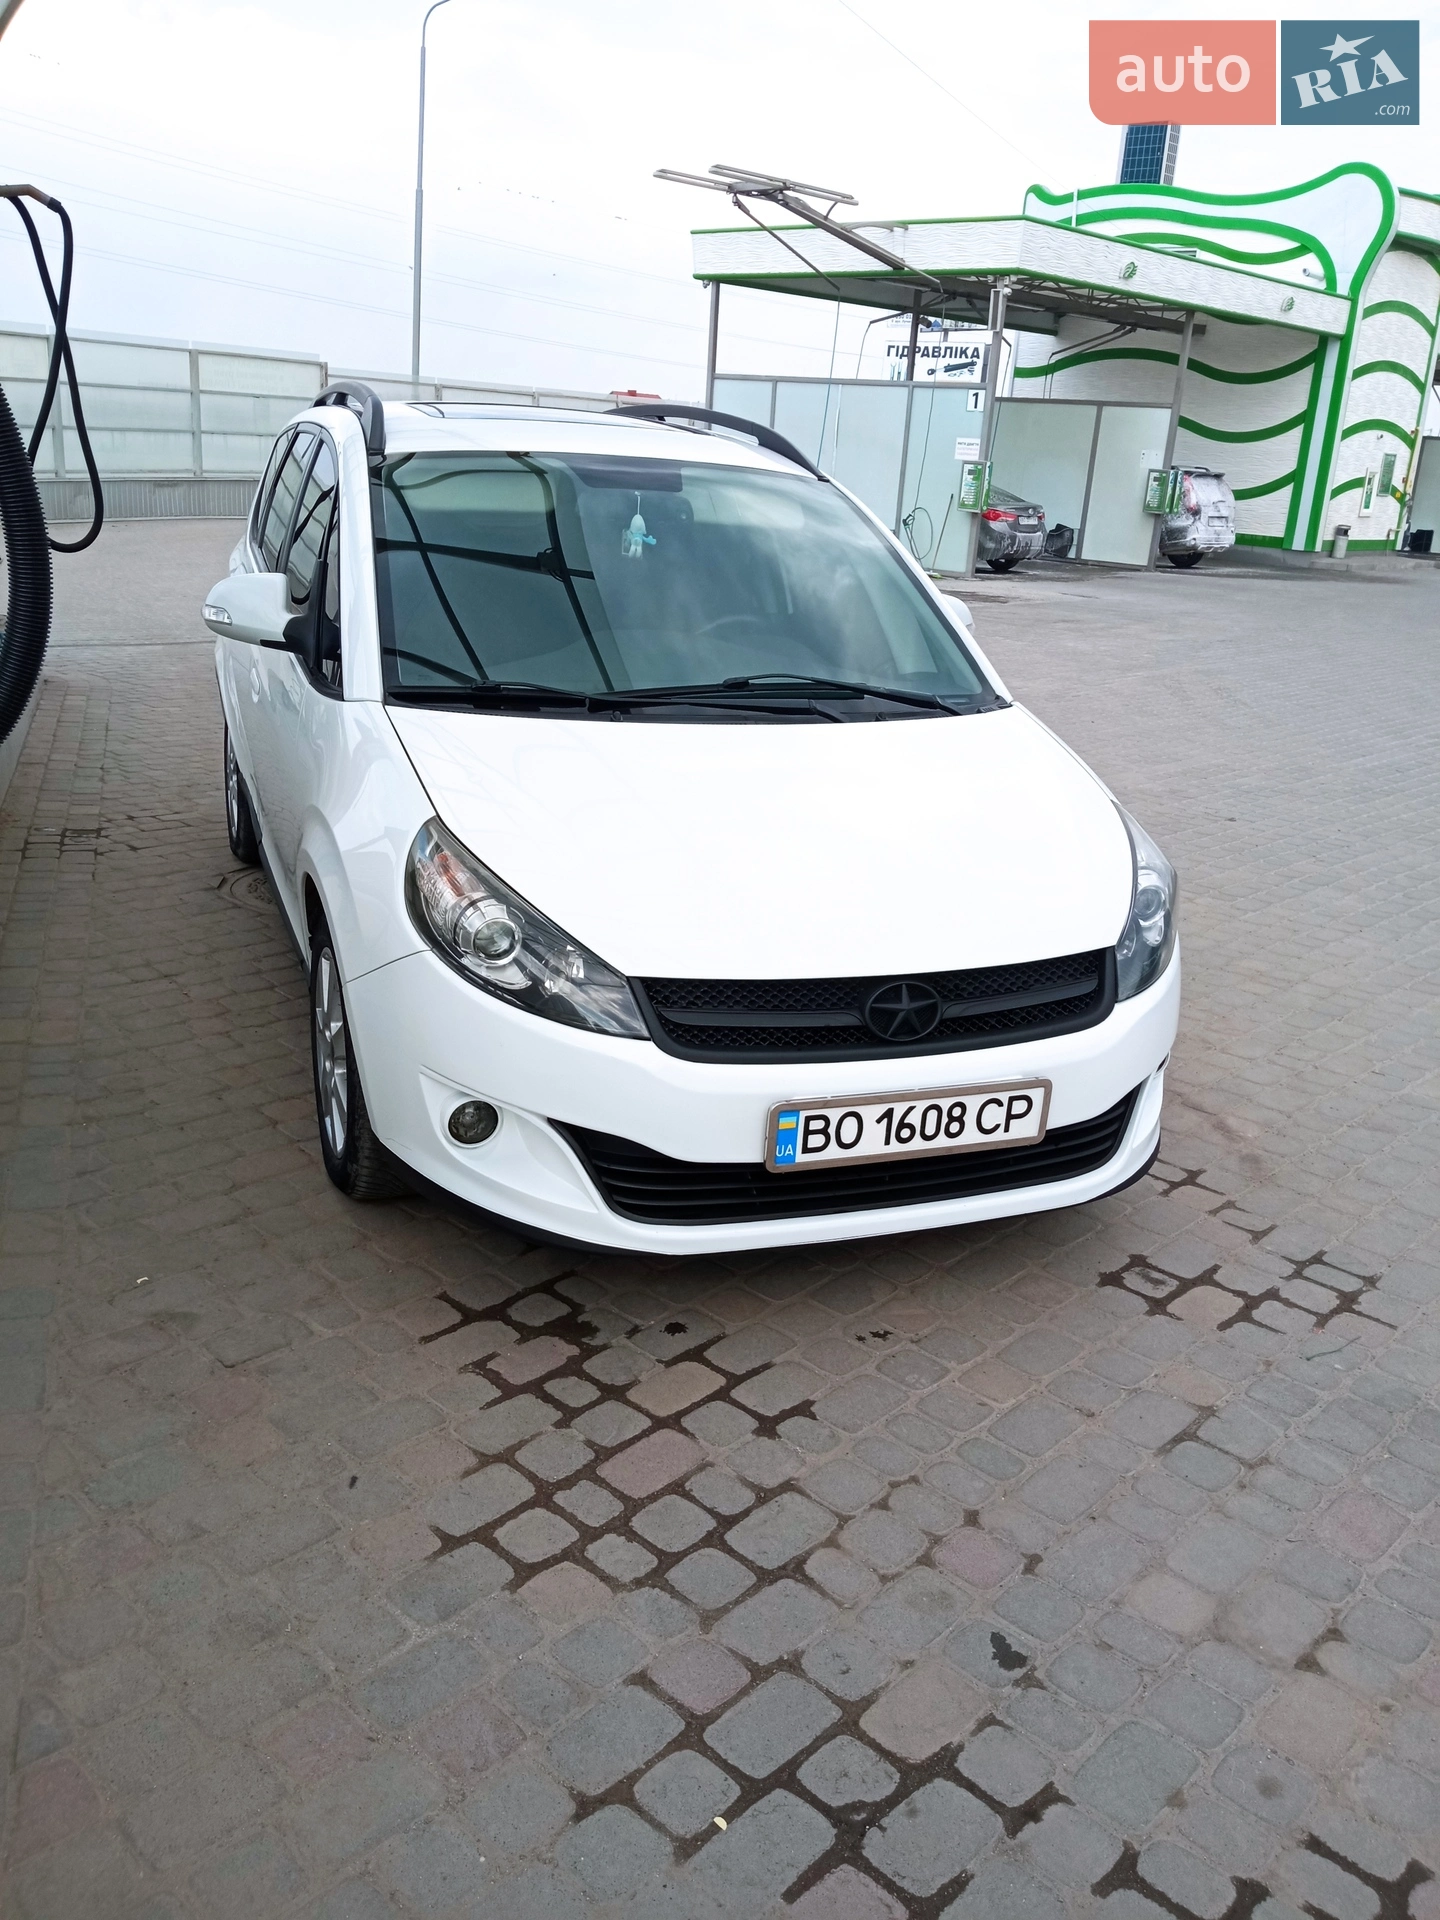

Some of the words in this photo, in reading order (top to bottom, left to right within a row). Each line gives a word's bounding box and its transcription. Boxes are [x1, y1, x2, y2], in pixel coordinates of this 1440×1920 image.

[886, 344, 981, 360] ГІДРАВЛІКА
[972, 391, 980, 410] 1
[801, 1110, 864, 1155] BO
[875, 1101, 967, 1146] 1608
[975, 1094, 1034, 1136] CP
[775, 1144, 795, 1158] UA
